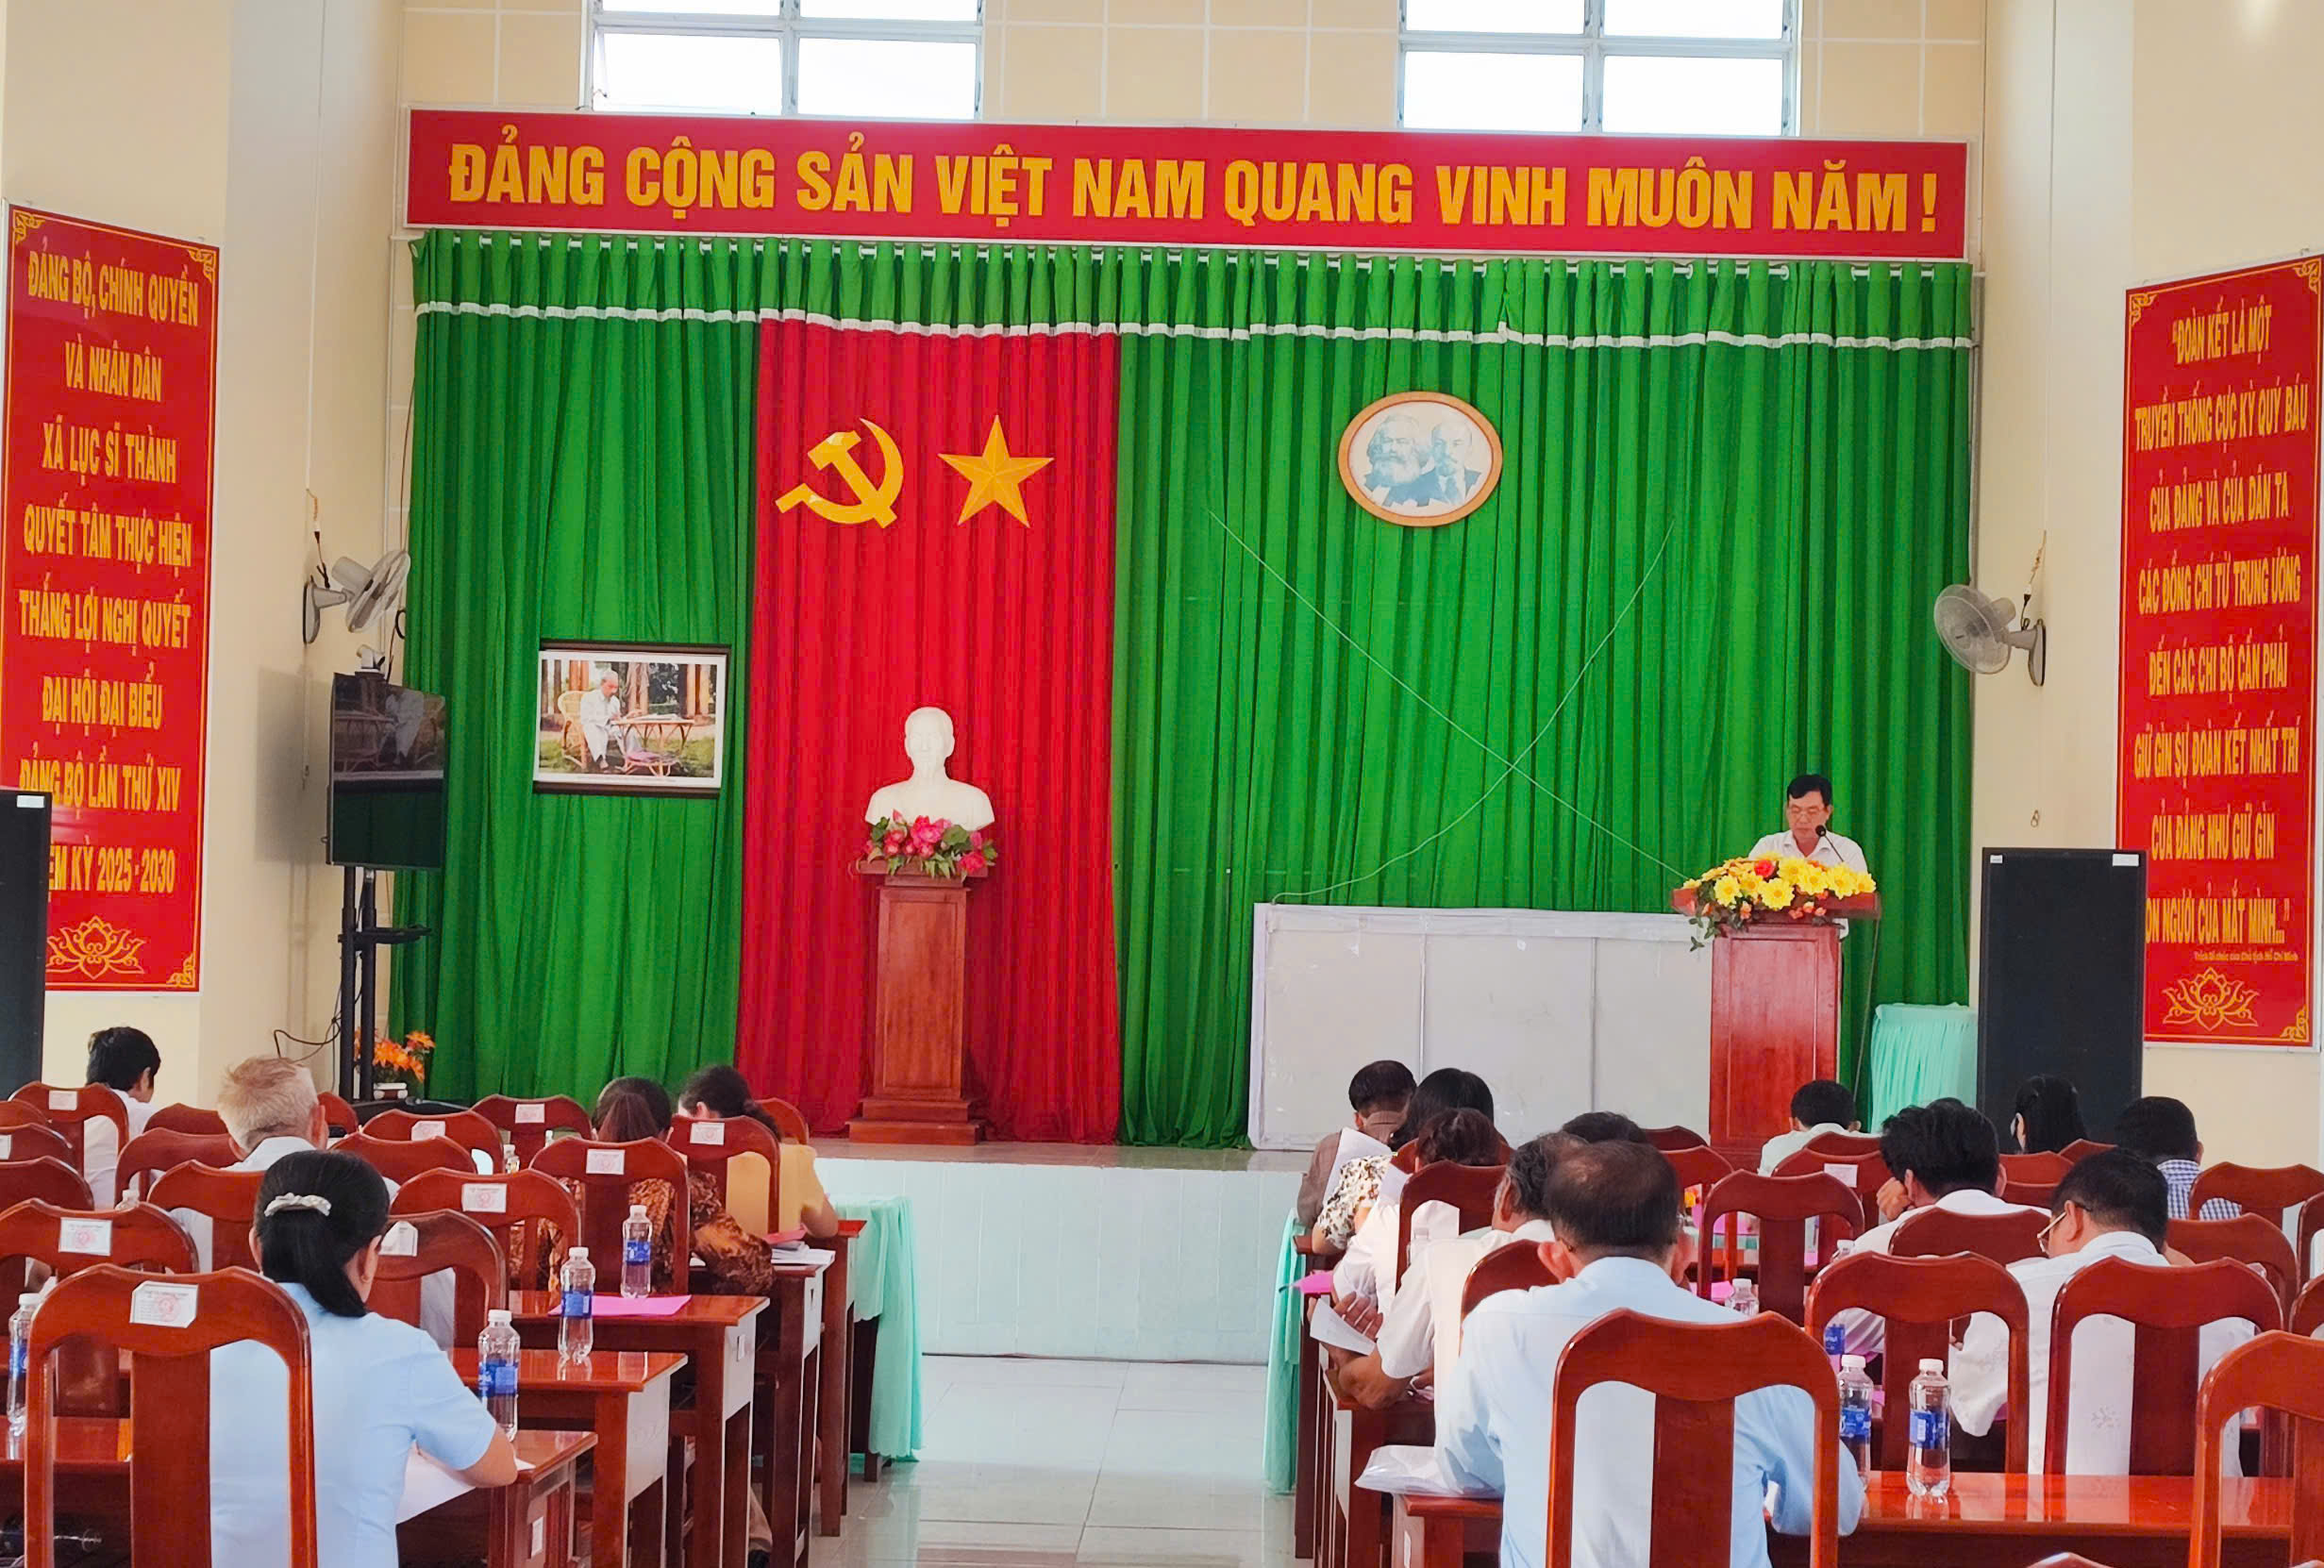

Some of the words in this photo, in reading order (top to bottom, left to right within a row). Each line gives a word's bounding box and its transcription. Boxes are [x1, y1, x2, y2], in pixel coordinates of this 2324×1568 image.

[449, 124, 605, 206] ĐẢNG
[626, 136, 776, 220] CỘNG
[796, 131, 913, 213] SẢN
[935, 143, 1053, 227] VIỆT
[1073, 158, 1206, 220] NAM
[1224, 159, 1413, 227] QUANG
[1435, 165, 1567, 225] VINH
[1587, 156, 1753, 230] MUÔN
[1772, 158, 1908, 232] NĂM
[27, 236, 69, 303] ĐẢNG
[73, 250, 96, 320] BỘ,
[99, 258, 143, 317] CHÍNH
[147, 265, 199, 327] QUYỀN
[65, 333, 84, 390] VÀ
[88, 340, 129, 397] NHÂN
[132, 345, 162, 403] DÂN
[2208, 295, 2229, 359] KẾT
[2232, 298, 2245, 355] LÀ
[2248, 294, 2272, 365] MỘT
[42, 414, 64, 471] XÃ
[70, 426, 100, 487] LỤC
[125, 425, 177, 484] THÀNH
[2134, 385, 2176, 452] TRUYỀN
[2178, 379, 2213, 446] THỐNG
[2215, 384, 2237, 453] CỰC
[2239, 379, 2256, 439] KỲ
[2257, 375, 2282, 437] QUÝ
[2283, 373, 2309, 432] BÁU
[24, 492, 75, 556] QUYẾT
[80, 502, 111, 559] TÂM
[115, 508, 154, 575] THỰC
[158, 512, 192, 578] HIỆN
[2149, 468, 2170, 534] CỦA
[2173, 466, 2203, 530] ĐẢNG
[2206, 468, 2219, 526] VÀ
[2222, 459, 2245, 525] CỦA
[2248, 463, 2270, 522] DÂN
[2274, 471, 2289, 519] TA
[19, 572, 72, 640] THẮNG
[75, 586, 98, 654] LỢI
[102, 597, 138, 657] NGHỊ
[142, 588, 192, 649] QUYẾT
[2138, 558, 2160, 615] CÁC
[2162, 549, 2192, 613] ĐỒNG
[2194, 551, 2213, 611] CHÍ
[2215, 550, 2232, 609] TỪ
[2232, 557, 2269, 607] TRUNG
[2271, 546, 2301, 605] ƯƠNG
[42, 676, 68, 736] ĐẠI
[71, 668, 97, 737] HỘI
[99, 679, 125, 738] ĐẠI
[128, 661, 163, 730] BIỂU
[2148, 634, 2170, 696] ĐẾN
[2173, 636, 2196, 695] CÁC
[2198, 645, 2217, 694] CHI
[2220, 633, 2234, 705] BỘ
[2237, 627, 2261, 692] CẦN
[2262, 623, 2288, 689] PHẢI
[19, 742, 60, 808] ĐẢNG
[63, 750, 84, 820] BỘ
[88, 745, 118, 809] LẦN
[123, 753, 154, 812] THỨ
[156, 765, 181, 812] XIV
[2154, 721, 2172, 778] GÌN
[2174, 721, 2190, 790] SỰ
[2192, 718, 2221, 777] ĐOÀN
[2224, 711, 2247, 776] KẾT
[2249, 709, 2279, 775] NHẤT
[2282, 715, 2301, 775] TRÍ
[71, 834, 94, 892] KỲ
[2151, 797, 2173, 860] CỦA
[2175, 797, 2205, 860] ĐẢNG
[2207, 803, 2231, 860] NHƯ
[2254, 801, 2275, 860] GÌN
[2145, 897, 2160, 943] ON
[2198, 881, 2219, 943] CỦA
